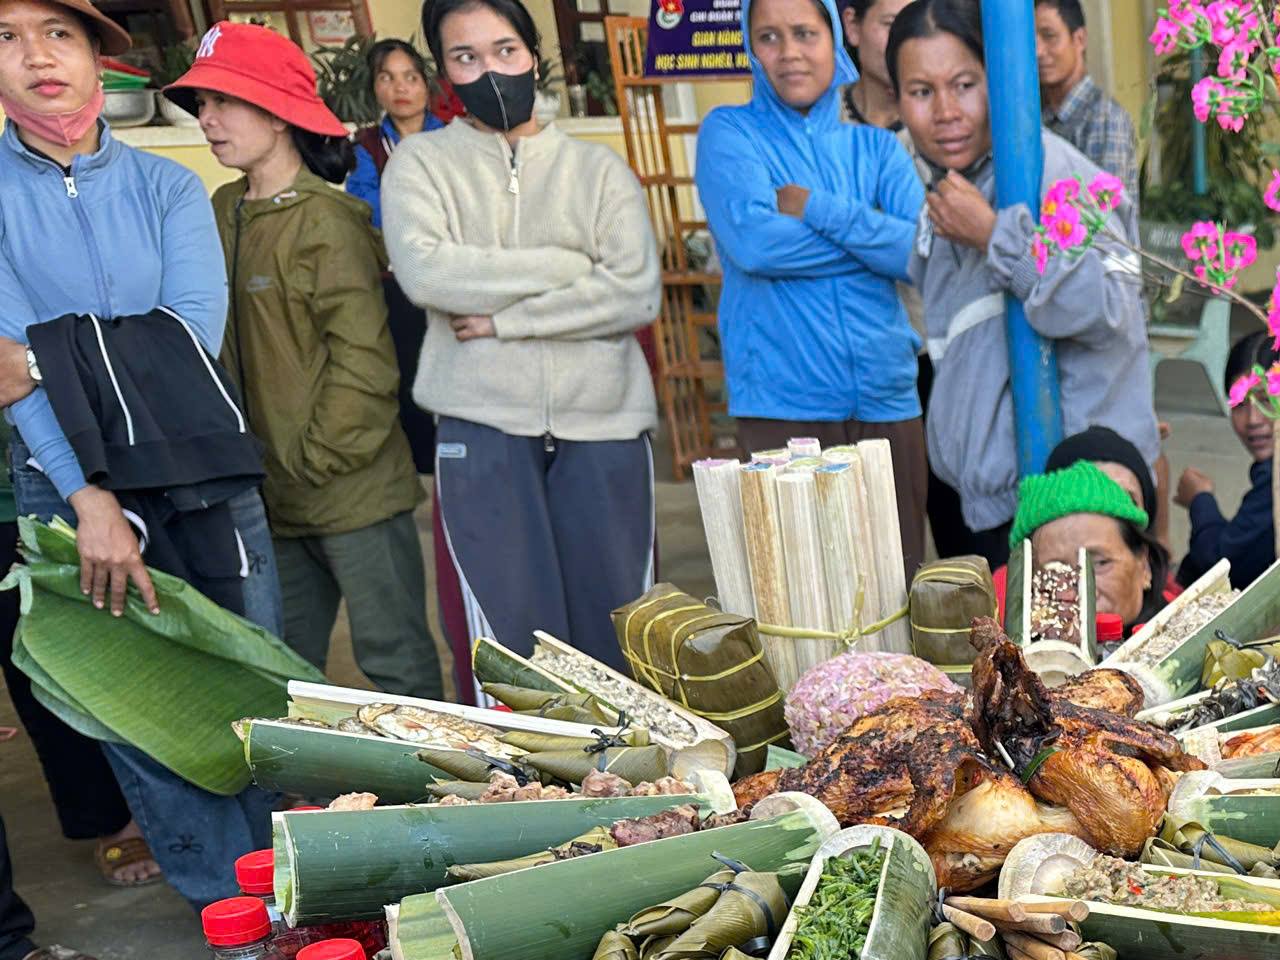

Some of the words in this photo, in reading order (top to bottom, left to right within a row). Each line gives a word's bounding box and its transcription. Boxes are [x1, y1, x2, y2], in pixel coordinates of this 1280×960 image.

[692, 31, 716, 46] GIAN
[655, 54, 676, 73] HỌC
[677, 54, 700, 70] SINH
